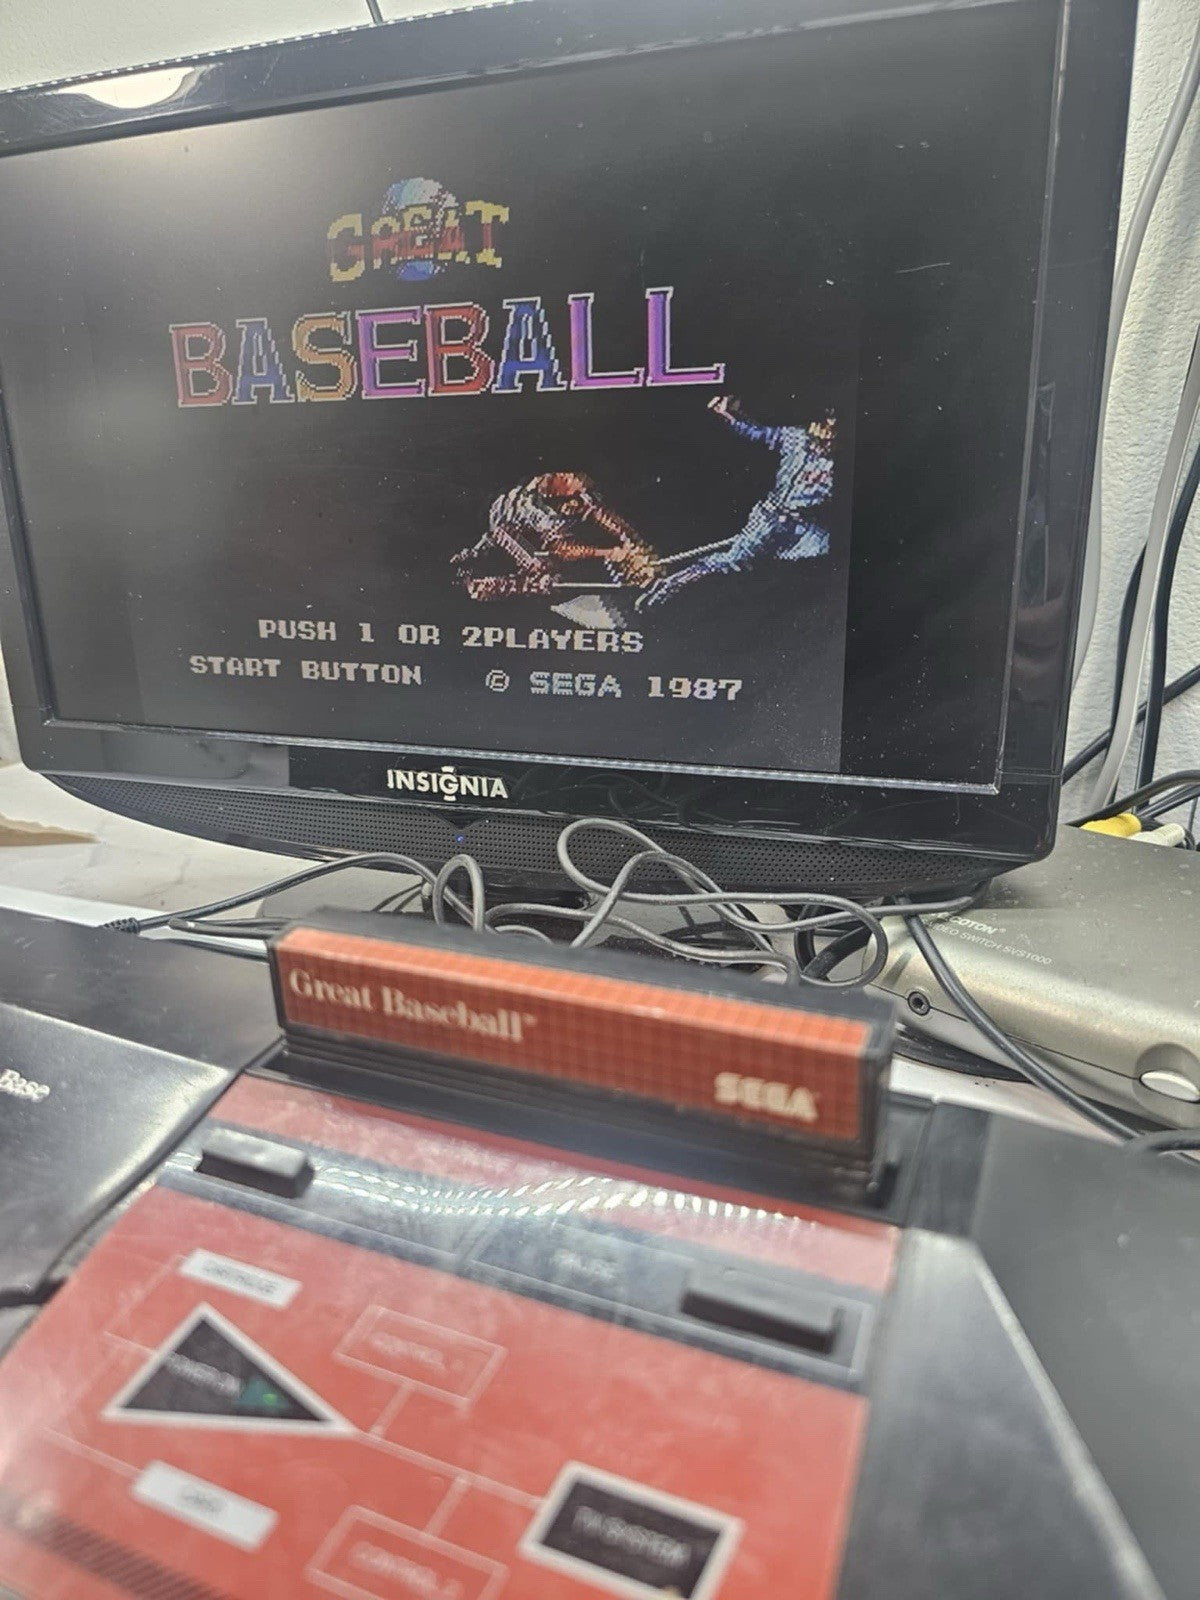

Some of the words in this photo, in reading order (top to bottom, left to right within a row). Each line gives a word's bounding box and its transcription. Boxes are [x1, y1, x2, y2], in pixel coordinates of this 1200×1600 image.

[327, 200, 510, 282] GREAT
[169, 286, 726, 408] BASEBALL
[258, 619, 337, 641] PUSH
[358, 622, 375, 643] 1
[398, 624, 440, 645] OR
[462, 626, 644, 653] 2PLAYERS
[189, 655, 281, 677] START
[301, 660, 422, 685] BUTTON
[529, 671, 622, 698] SEGA
[648, 676, 743, 701] 1987
[386, 765, 509, 802] INSIGNIA
[289, 967, 372, 1012] Great
[713, 1071, 818, 1121] SEGA
